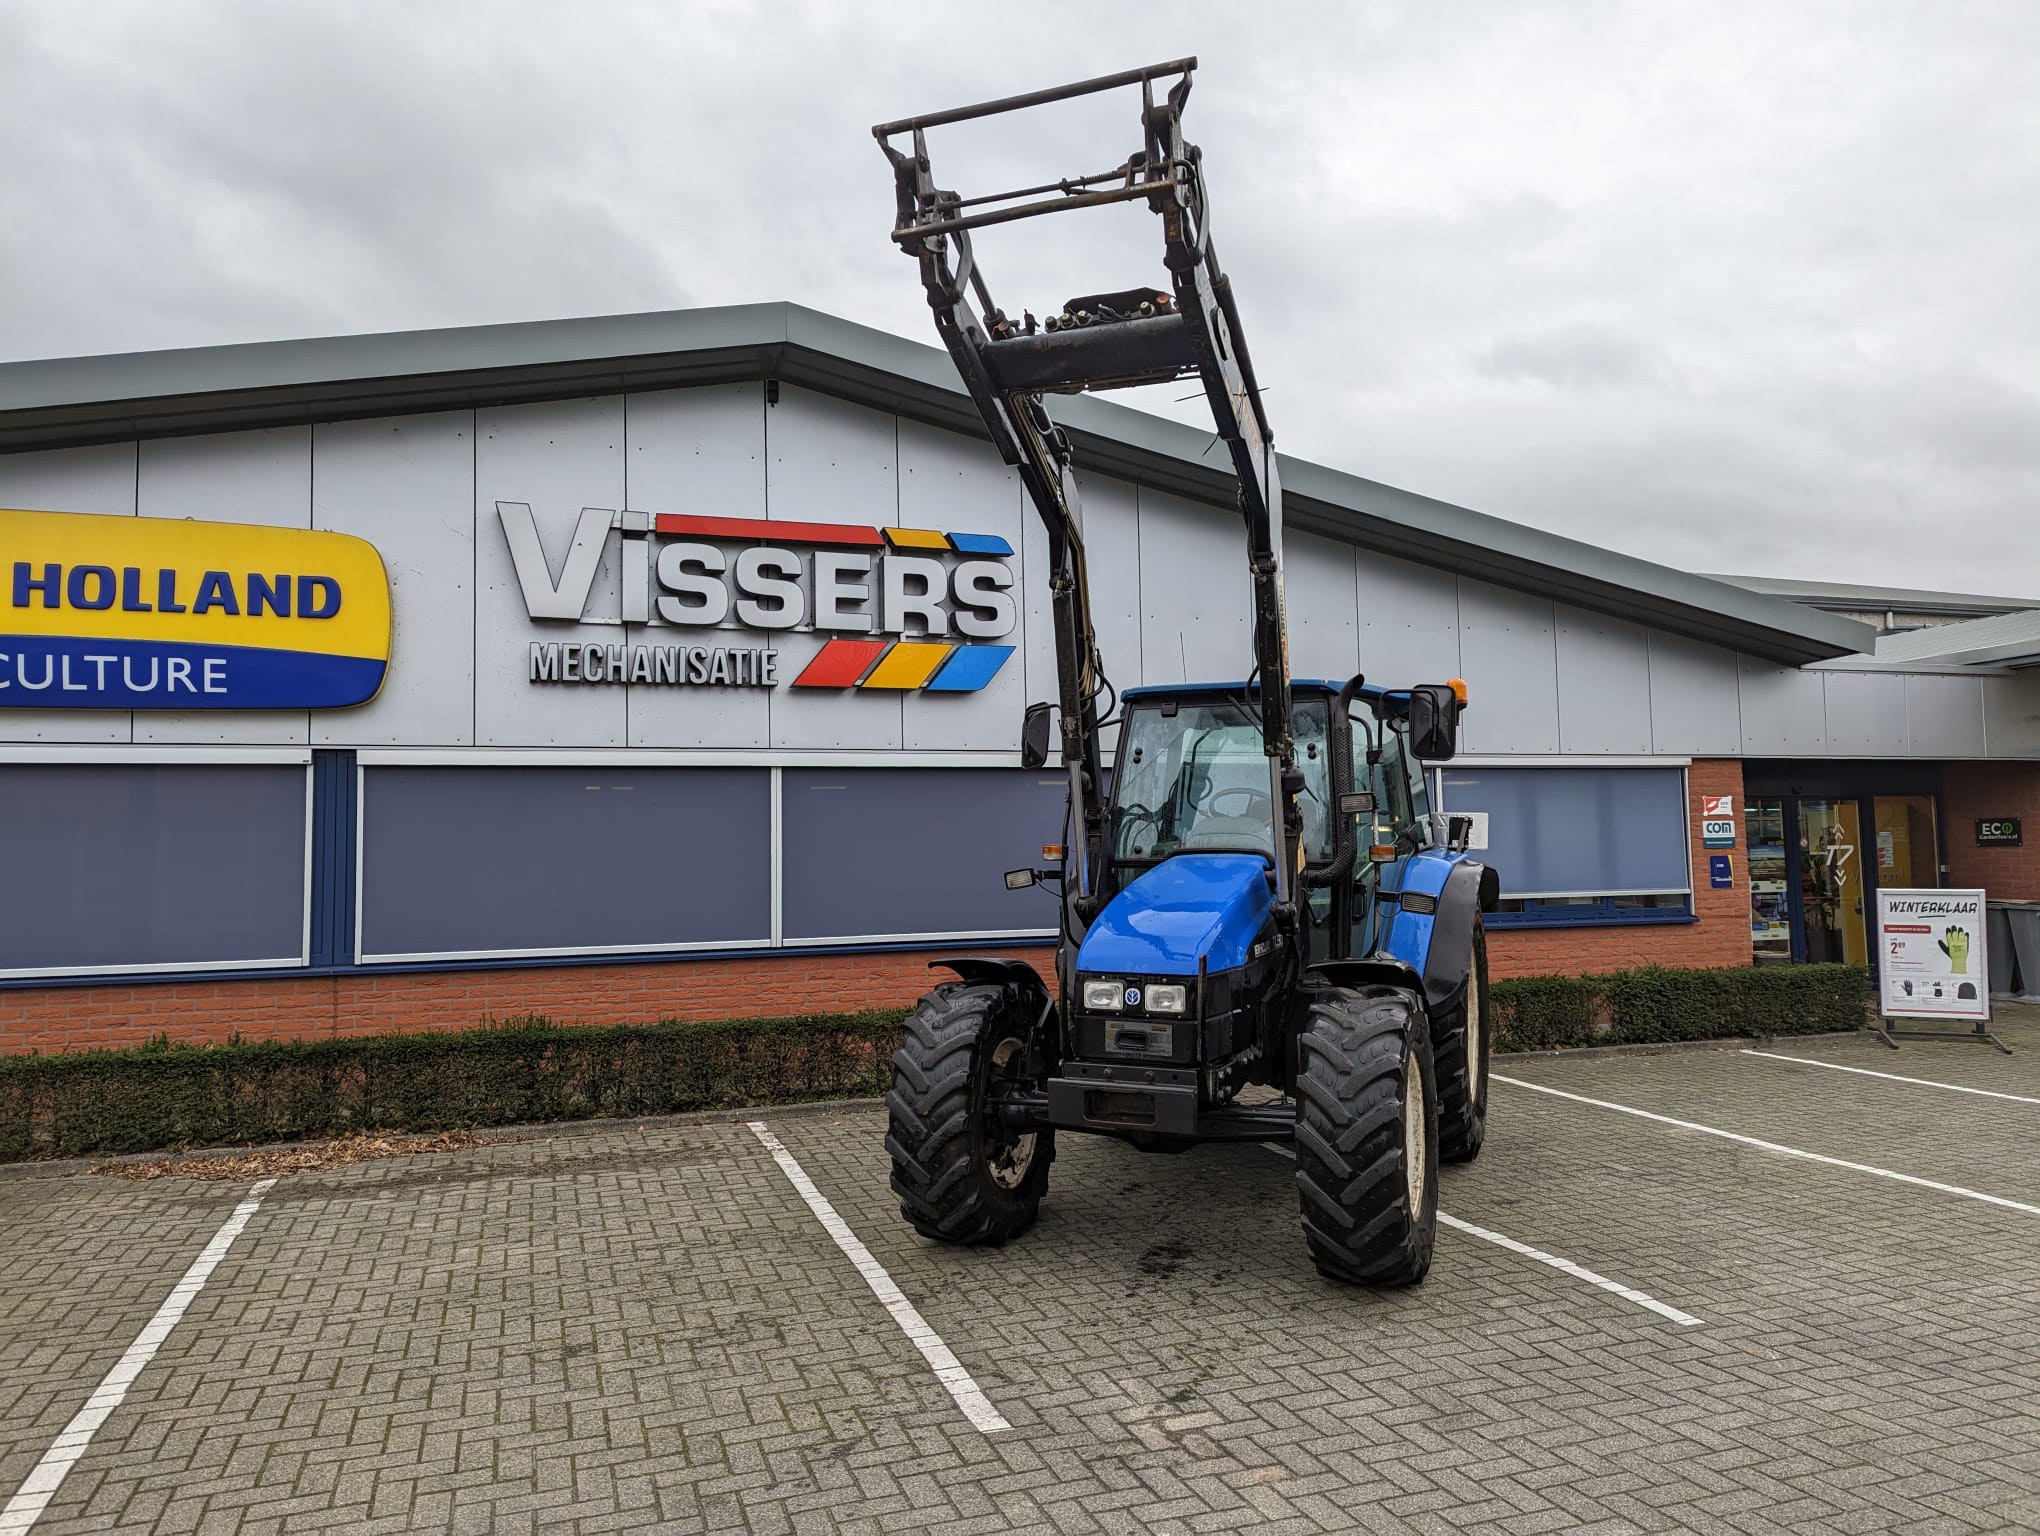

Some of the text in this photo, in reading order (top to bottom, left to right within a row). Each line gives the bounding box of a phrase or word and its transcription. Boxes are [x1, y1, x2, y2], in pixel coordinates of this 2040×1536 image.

[13, 562, 342, 619] HOLLAND
[529, 642, 778, 687] MECHANISATIE
[1826, 845, 1854, 866] T7
[1889, 901, 1978, 914] WINTERKLAAR
